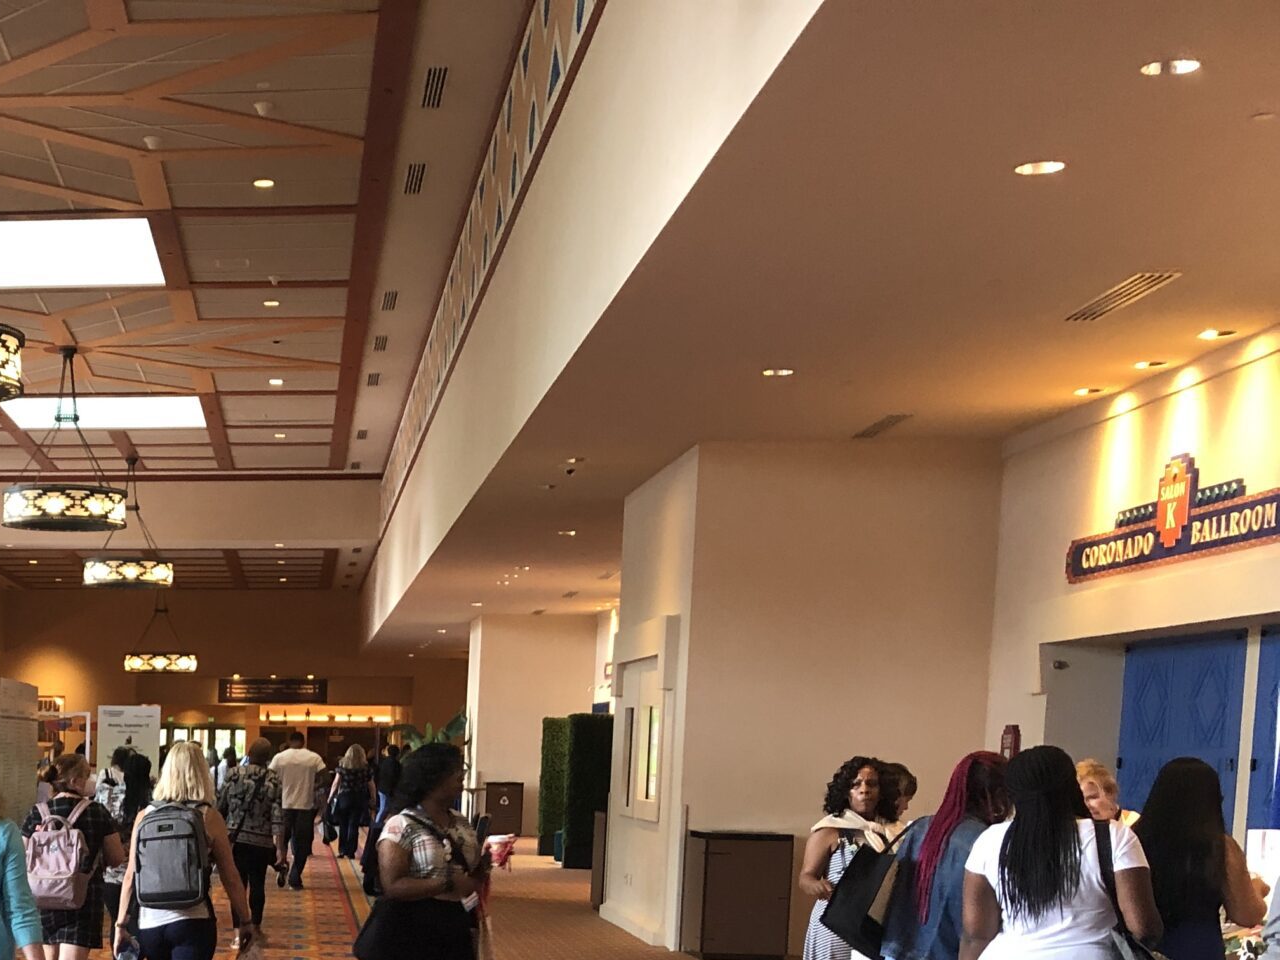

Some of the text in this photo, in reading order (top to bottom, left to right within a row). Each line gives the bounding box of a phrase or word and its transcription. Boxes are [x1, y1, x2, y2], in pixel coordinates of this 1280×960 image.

[1161, 481, 1185, 501] SALON
[1165, 502, 1176, 529] K
[1081, 502, 1277, 569] CORONADO BALLROOM
